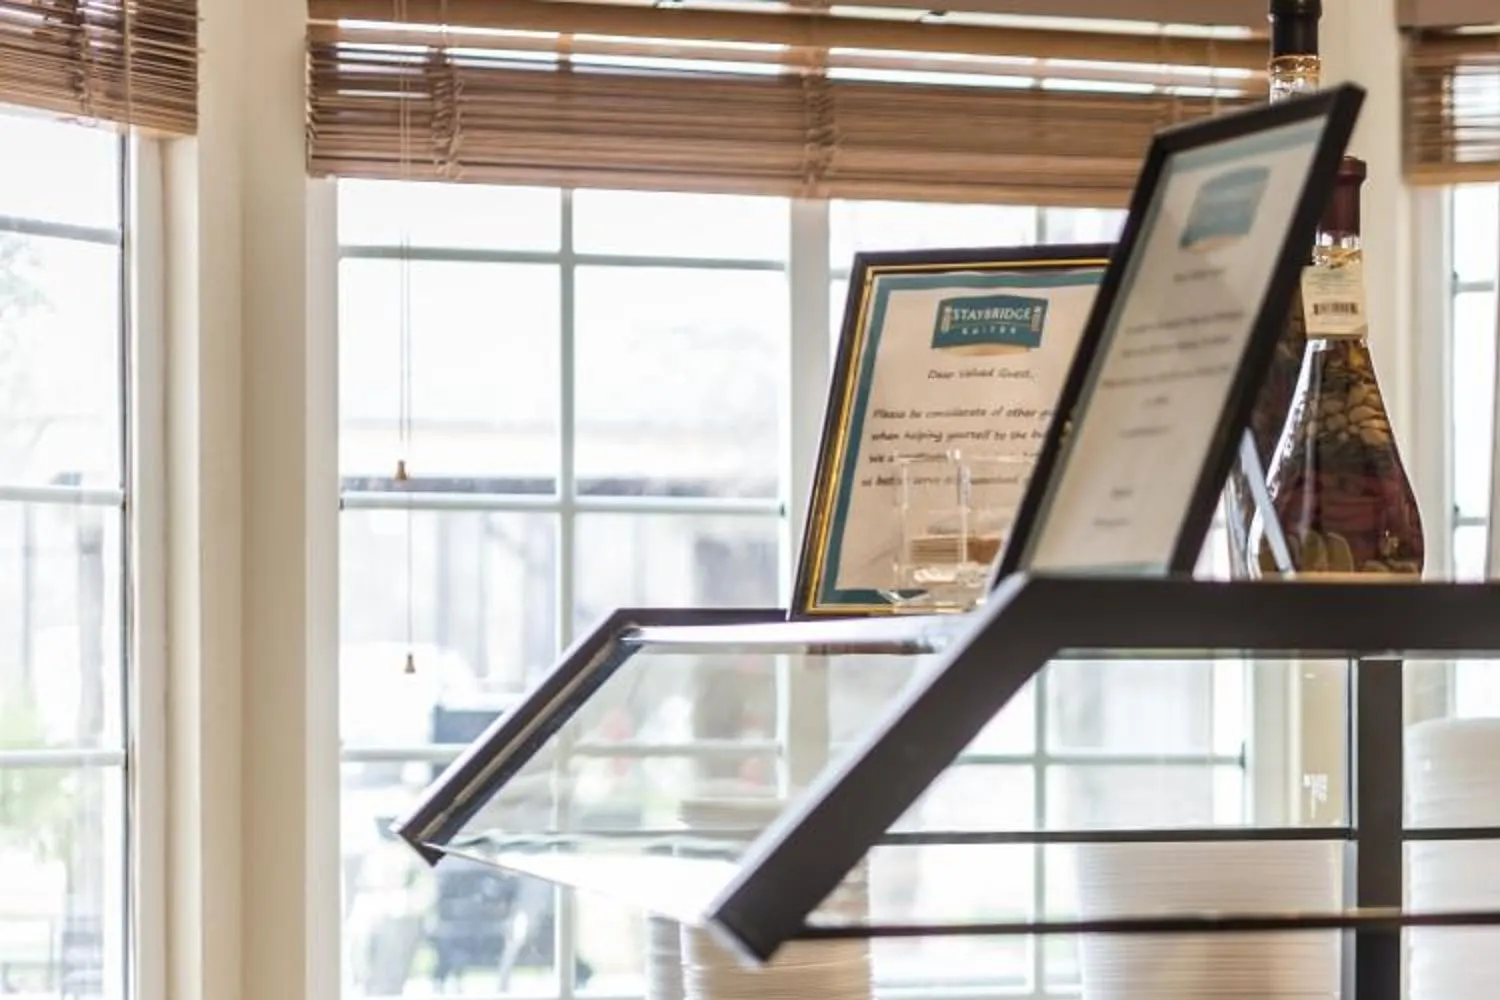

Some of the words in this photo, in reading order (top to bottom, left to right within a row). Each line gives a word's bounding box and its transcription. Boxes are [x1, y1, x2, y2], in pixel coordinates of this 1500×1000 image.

[953, 306, 1031, 321] STAYBRIDGE
[872, 408, 905, 419] Please
[1005, 407, 1037, 418] other
[871, 430, 900, 442] when
